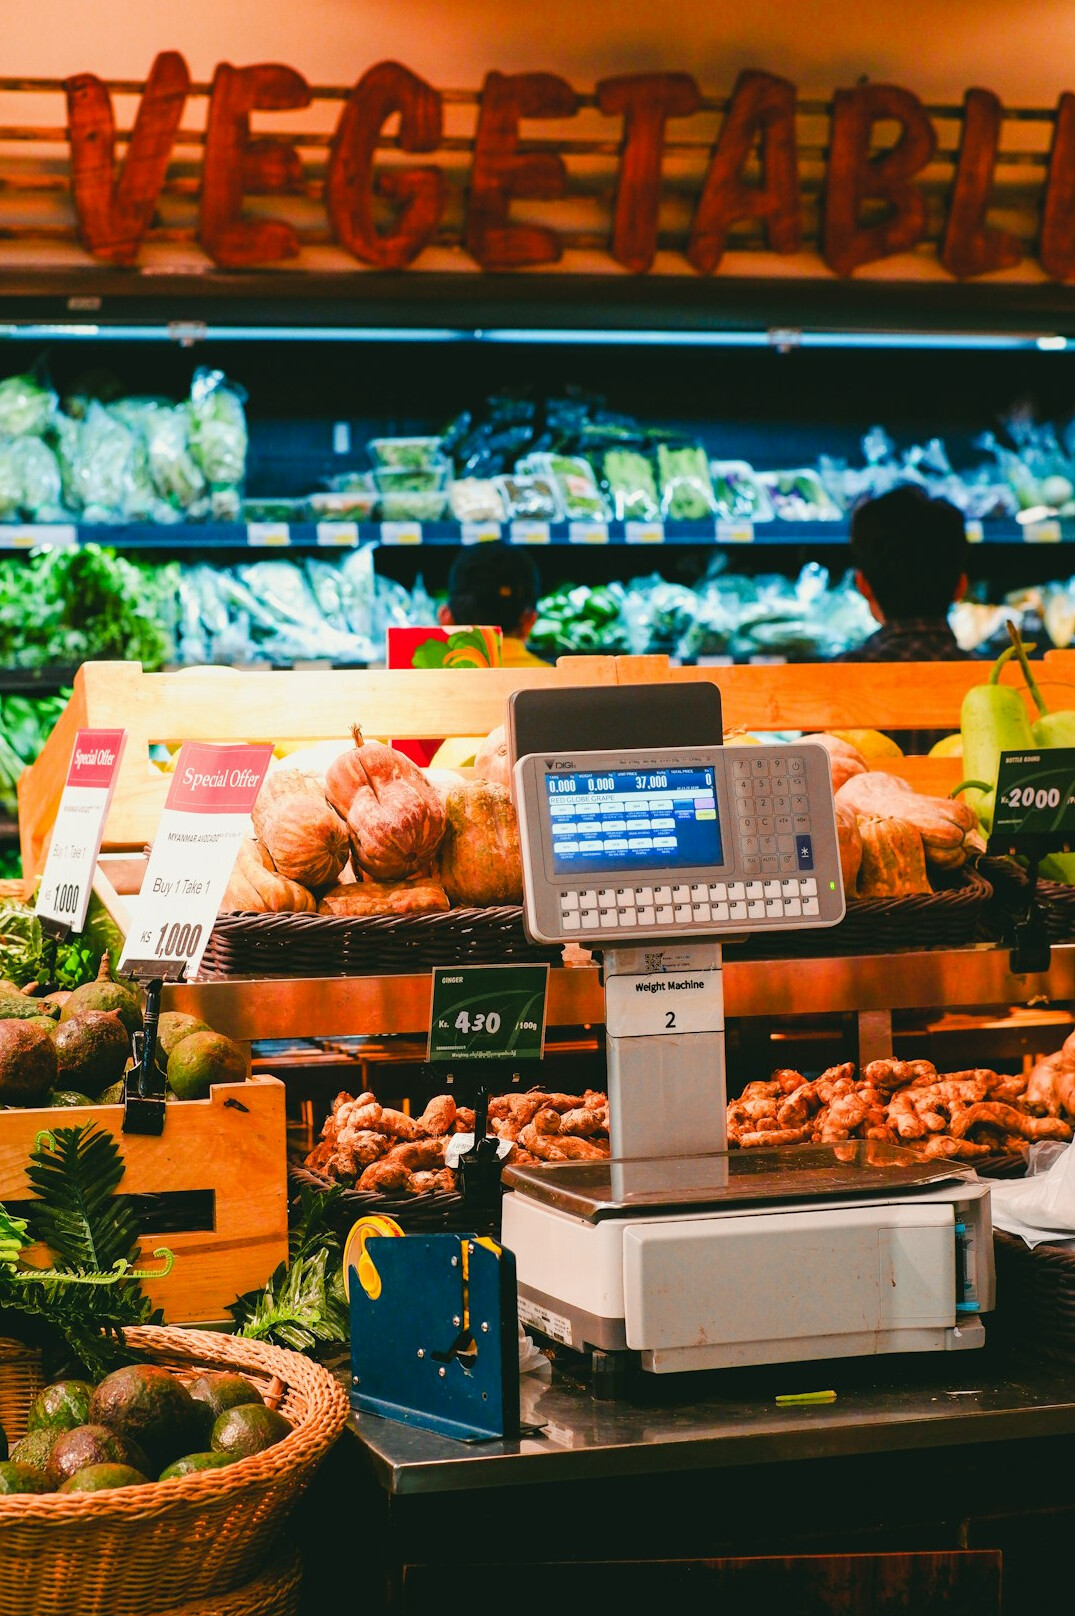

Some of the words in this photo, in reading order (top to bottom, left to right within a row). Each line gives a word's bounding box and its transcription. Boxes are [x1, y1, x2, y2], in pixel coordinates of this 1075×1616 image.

[74, 749, 98, 770] Special
[97, 750, 115, 766] Offer
[182, 767, 229, 791] Special
[229, 769, 260, 788] Offer
[549, 779, 576, 793] 0.000
[588, 777, 615, 791] 0.000
[635, 775, 668, 789] 37,000
[705, 773, 712, 786] 0
[1008, 787, 1060, 809] 2000
[167, 832, 197, 842] MYANMAR
[153, 877, 172, 897] Buy
[175, 880, 180, 894] 1
[182, 880, 202, 894] Take
[205, 880, 211, 894] 1
[54, 883, 80, 913] 1,000
[155, 923, 202, 958] 1,000
[441, 976, 464, 984] GINGER
[636, 982, 665, 993] Weight
[668, 980, 704, 990] Machine
[438, 1019, 449, 1028] Ks.
[454, 1010, 501, 1034] 430
[666, 1012, 676, 1028] 2
